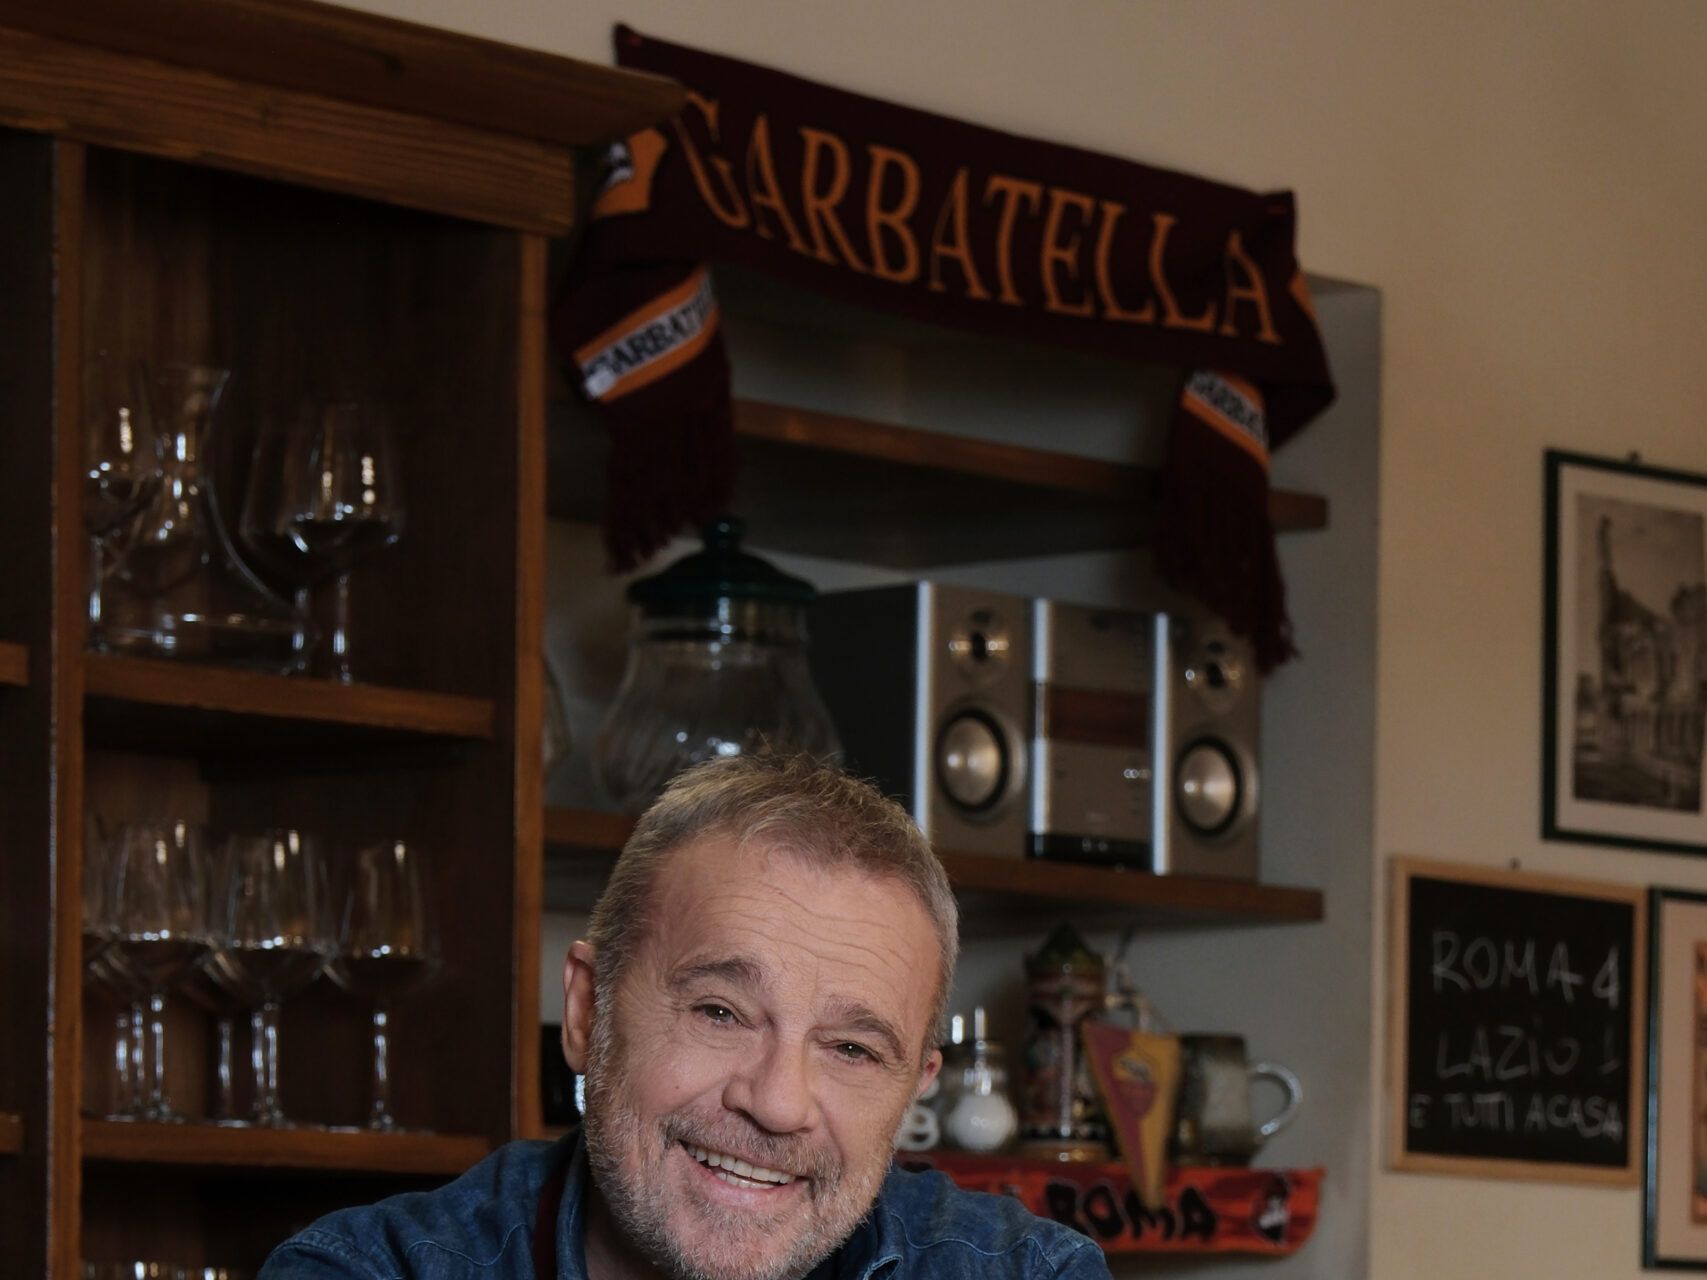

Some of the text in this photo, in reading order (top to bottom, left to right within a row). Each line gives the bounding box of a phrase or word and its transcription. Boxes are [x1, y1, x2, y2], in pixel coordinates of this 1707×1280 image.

[675, 92, 1283, 345] GARBATELLA
[1431, 929, 1585, 1004] ROMA
[1410, 1093, 1433, 1129] E
[1443, 1092, 1514, 1132] TUTTI
[1046, 1179, 1218, 1241] ROMA
